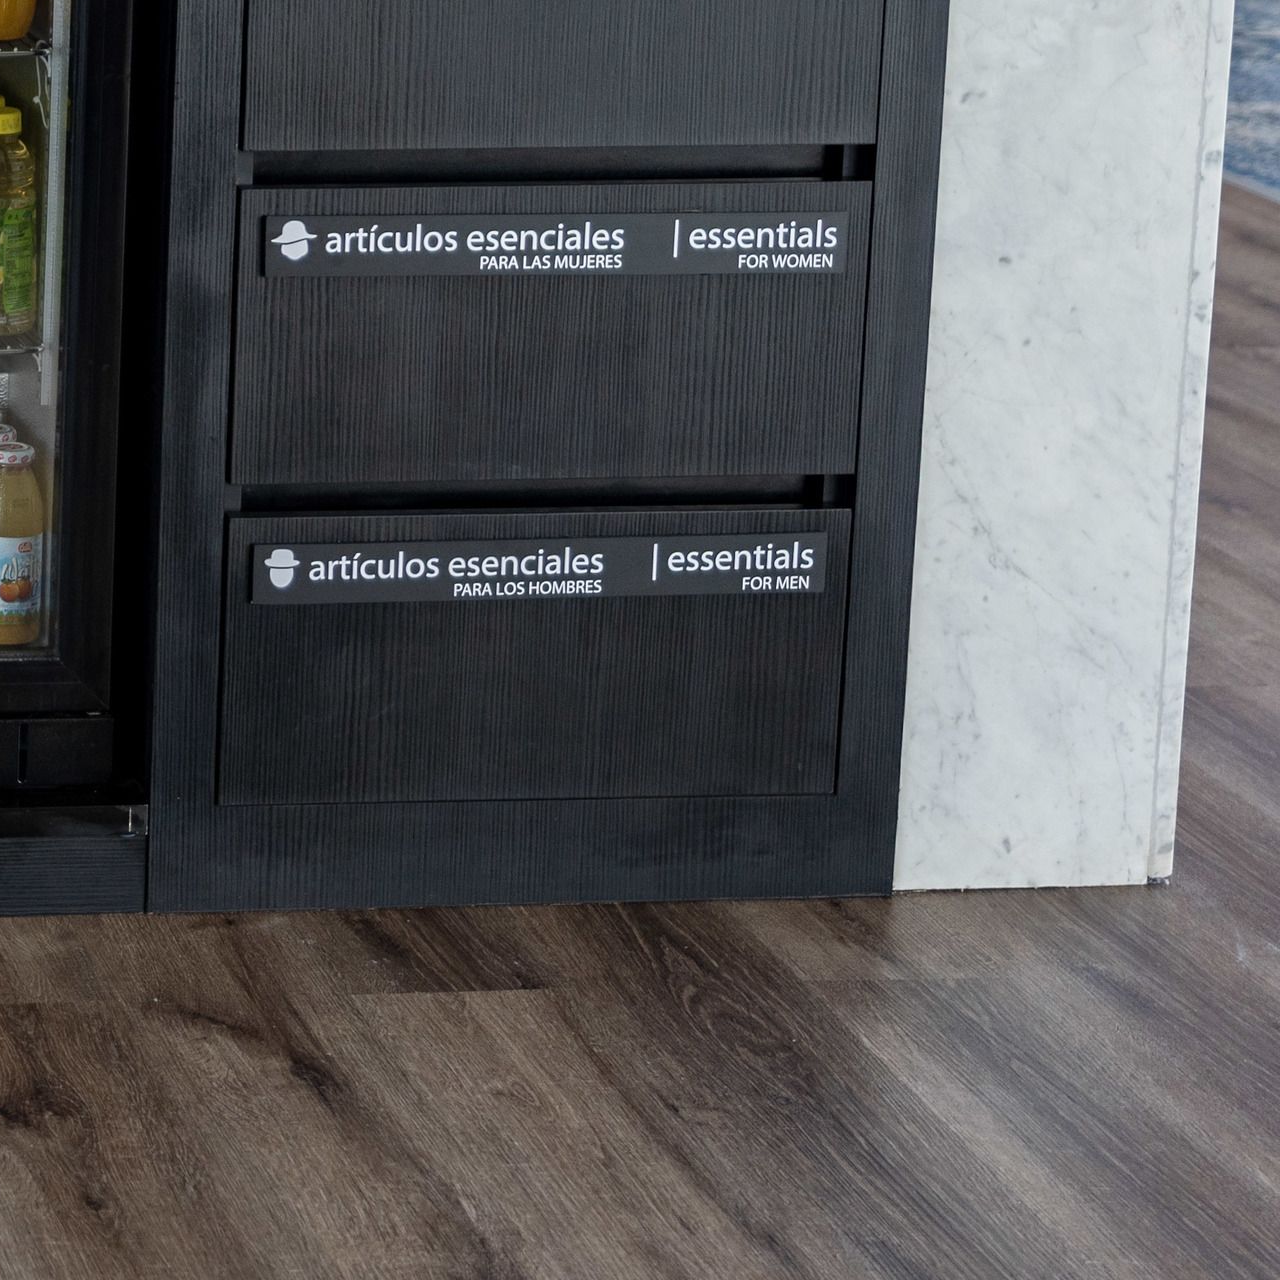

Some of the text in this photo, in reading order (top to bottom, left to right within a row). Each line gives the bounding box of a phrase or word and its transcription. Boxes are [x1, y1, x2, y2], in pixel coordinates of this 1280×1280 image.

[325, 219, 838, 253] artículos esenciales essentials
[479, 253, 834, 270] PARA LAS MUJERES FOR WOMEN
[308, 542, 814, 581] artículos esenciales essentials
[453, 575, 810, 597] PARA LOS HOMBRES FOR MEN
